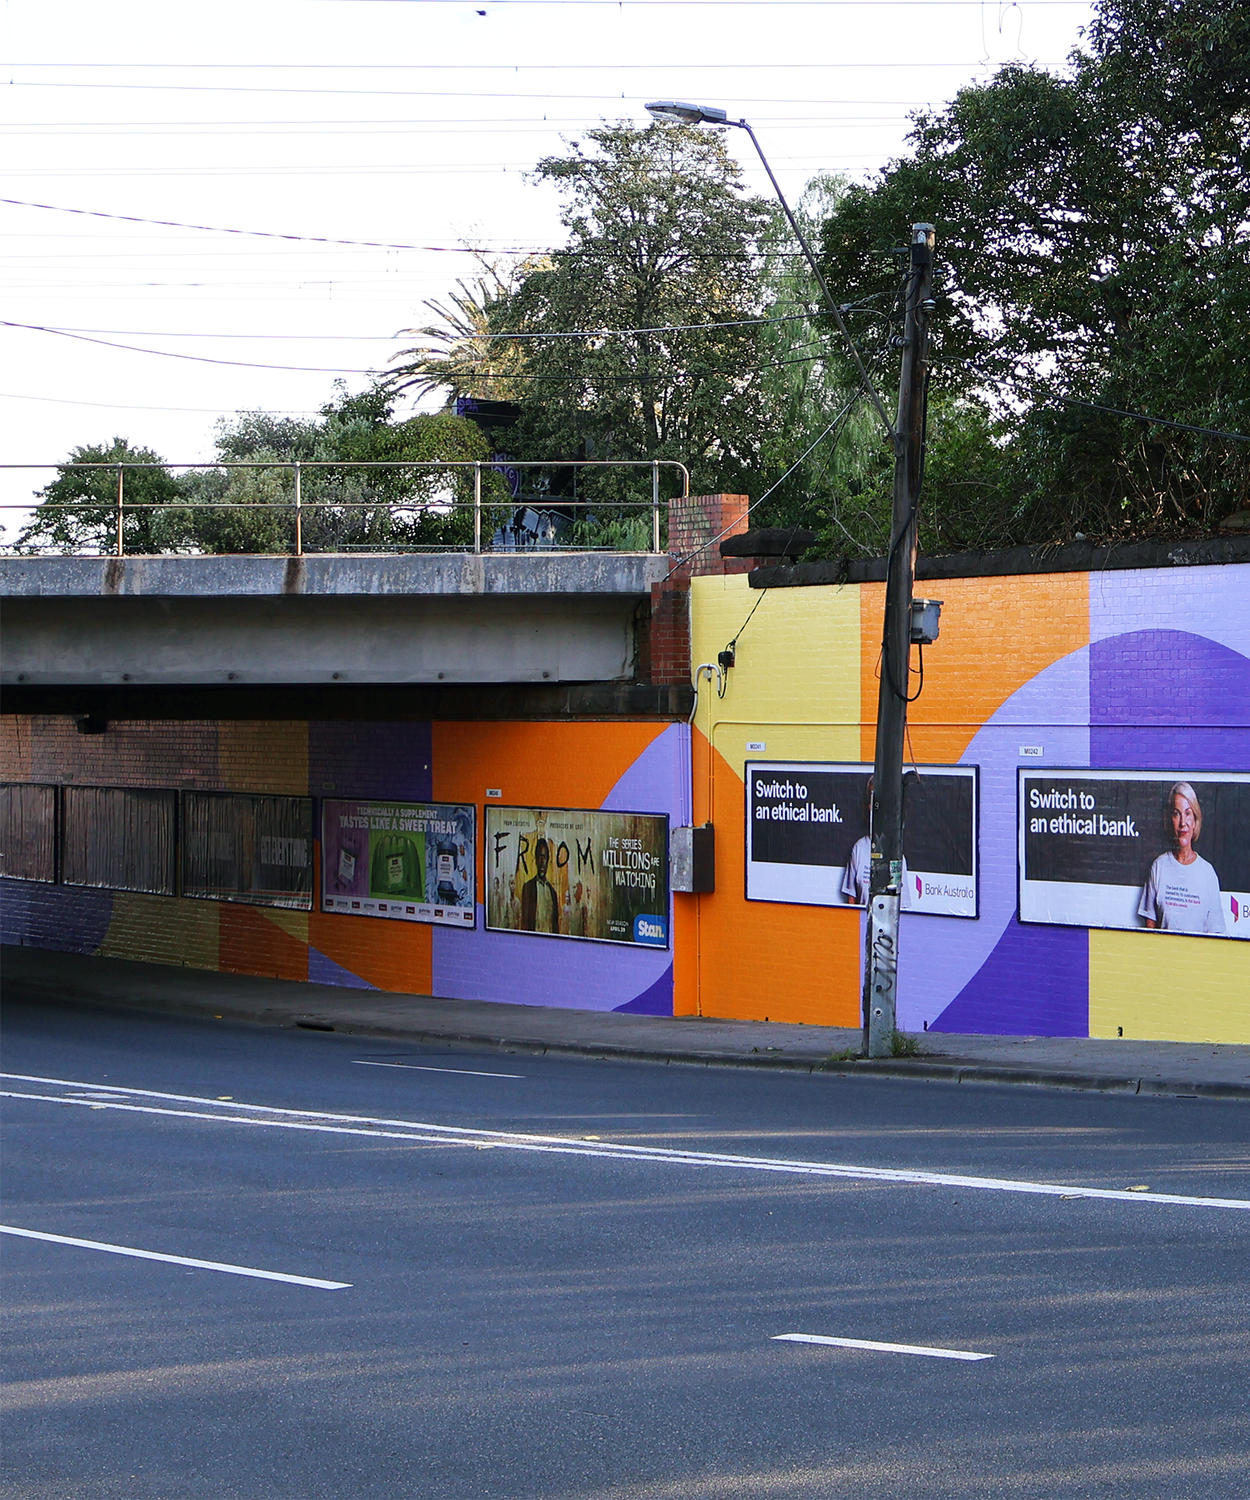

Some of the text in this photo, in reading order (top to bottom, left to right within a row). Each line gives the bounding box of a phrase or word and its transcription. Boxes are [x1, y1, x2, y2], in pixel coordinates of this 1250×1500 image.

[756, 779, 807, 799] Switch to
[1030, 788, 1094, 810] Switch to
[357, 806, 437, 819] TECHNICALLY A SUPPLEMENT
[756, 801, 842, 823] an ethical bank.
[339, 815, 457, 834] TASTES LIKE A SWEET TREAT
[1030, 813, 1139, 837] an ethical bank.
[609, 836, 642, 850] THE SERIES
[494, 831, 595, 875] FROM
[602, 849, 660, 870] MILLIONS ARE
[615, 870, 656, 889] WATCHING
[925, 883, 973, 898] Bank Australia
[638, 919, 665, 938] Stan.
